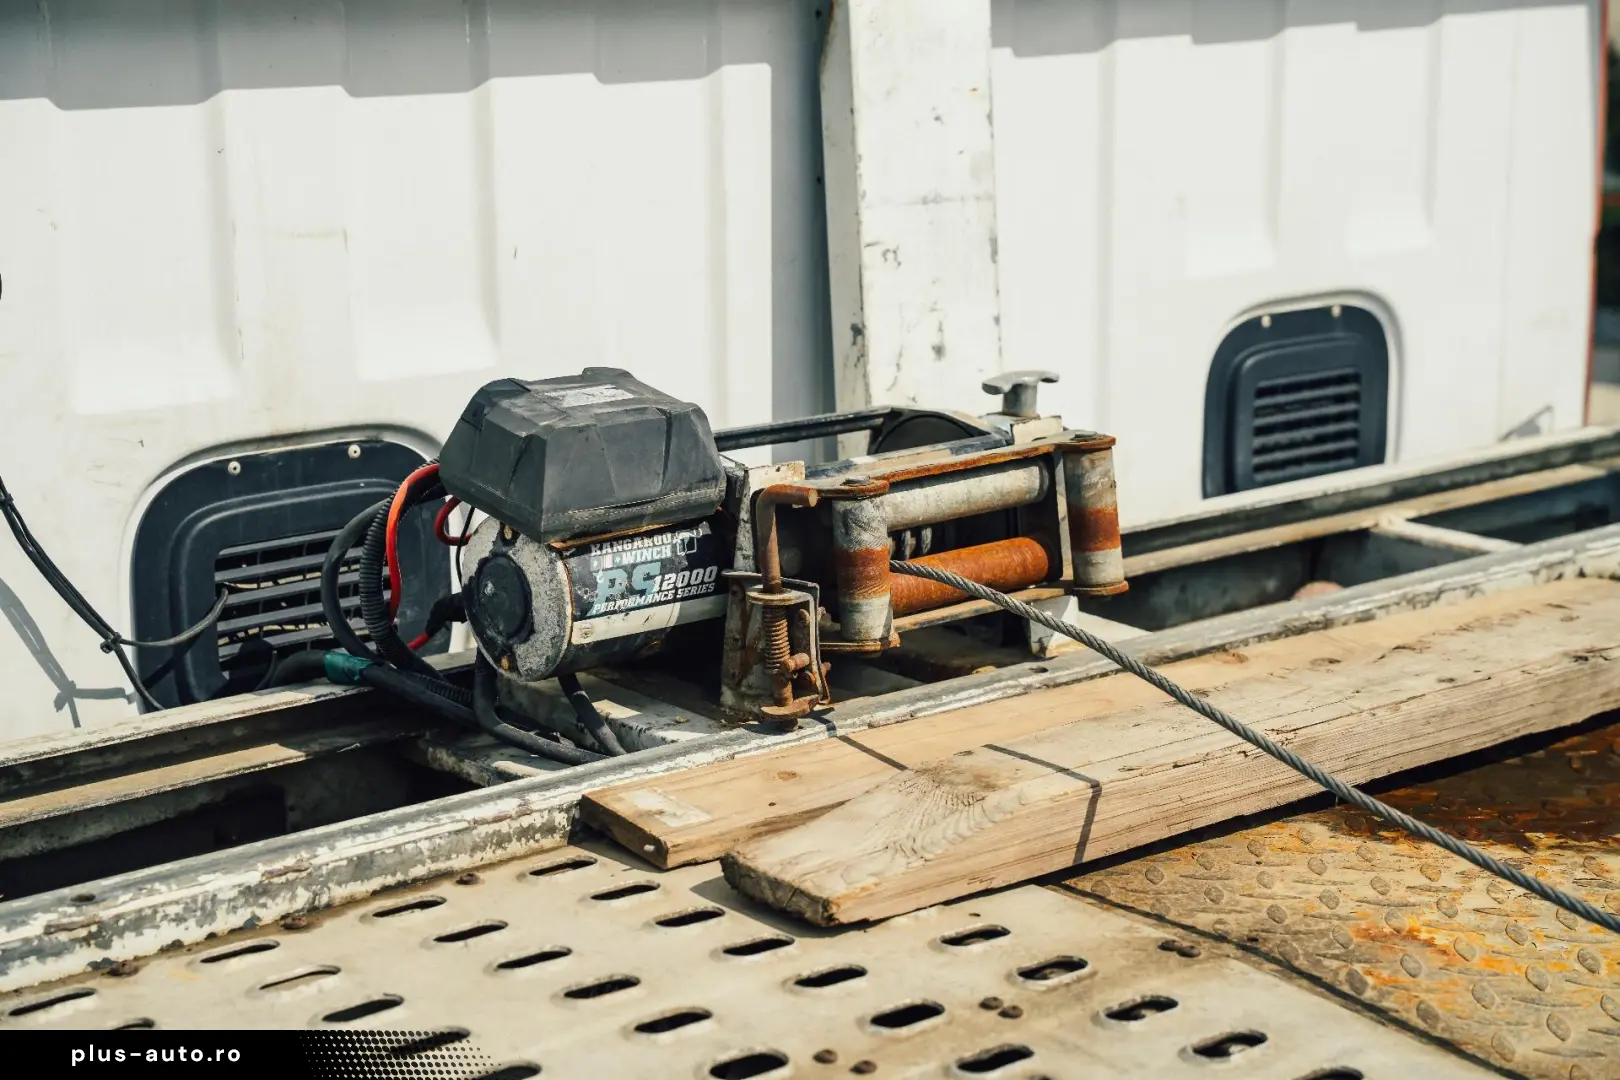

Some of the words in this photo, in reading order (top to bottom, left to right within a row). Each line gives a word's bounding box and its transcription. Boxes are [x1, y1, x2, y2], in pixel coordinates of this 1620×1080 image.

[621, 544, 672, 564] WINCH
[652, 566, 718, 593] 12000
[592, 589, 676, 613] PERFORMANCE
[677, 582, 716, 598] SERIES
